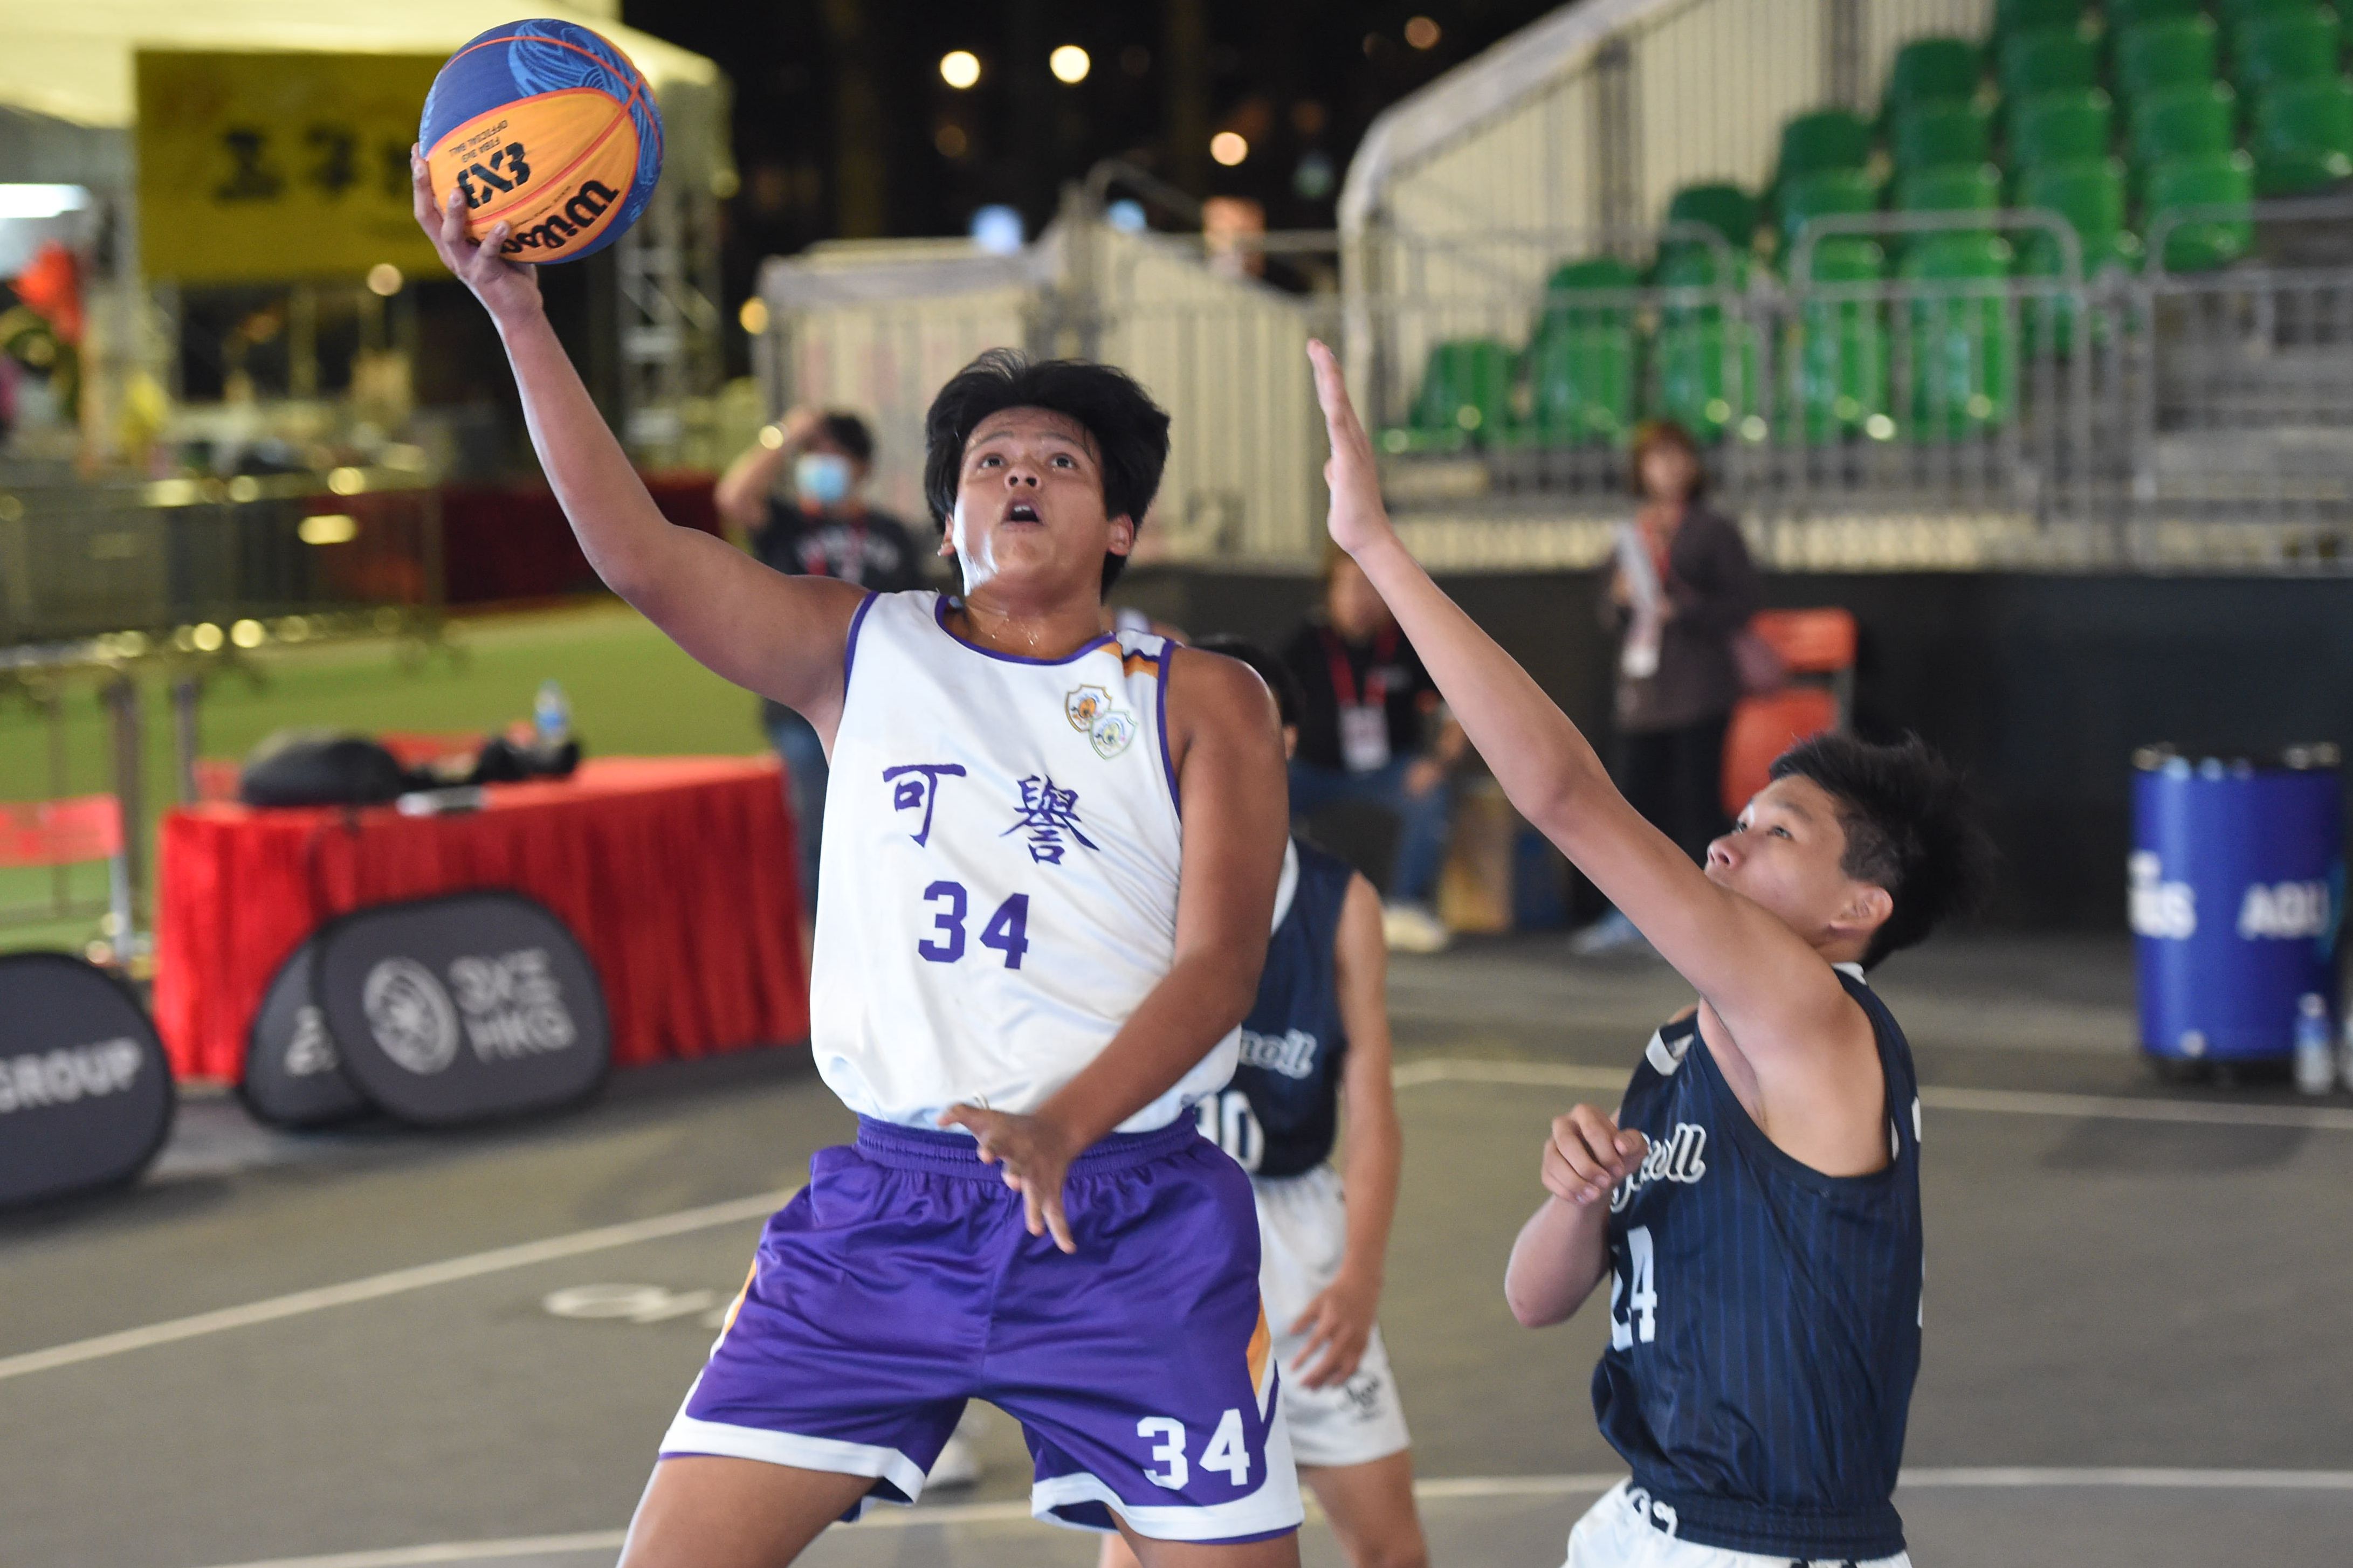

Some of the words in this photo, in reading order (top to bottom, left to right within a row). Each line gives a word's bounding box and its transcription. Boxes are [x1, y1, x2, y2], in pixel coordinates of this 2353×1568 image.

[467, 180, 620, 253] Wilso
[883, 763, 1100, 866] 可譽
[918, 880, 1030, 970] 34
[1137, 1407, 1251, 1490] 34
